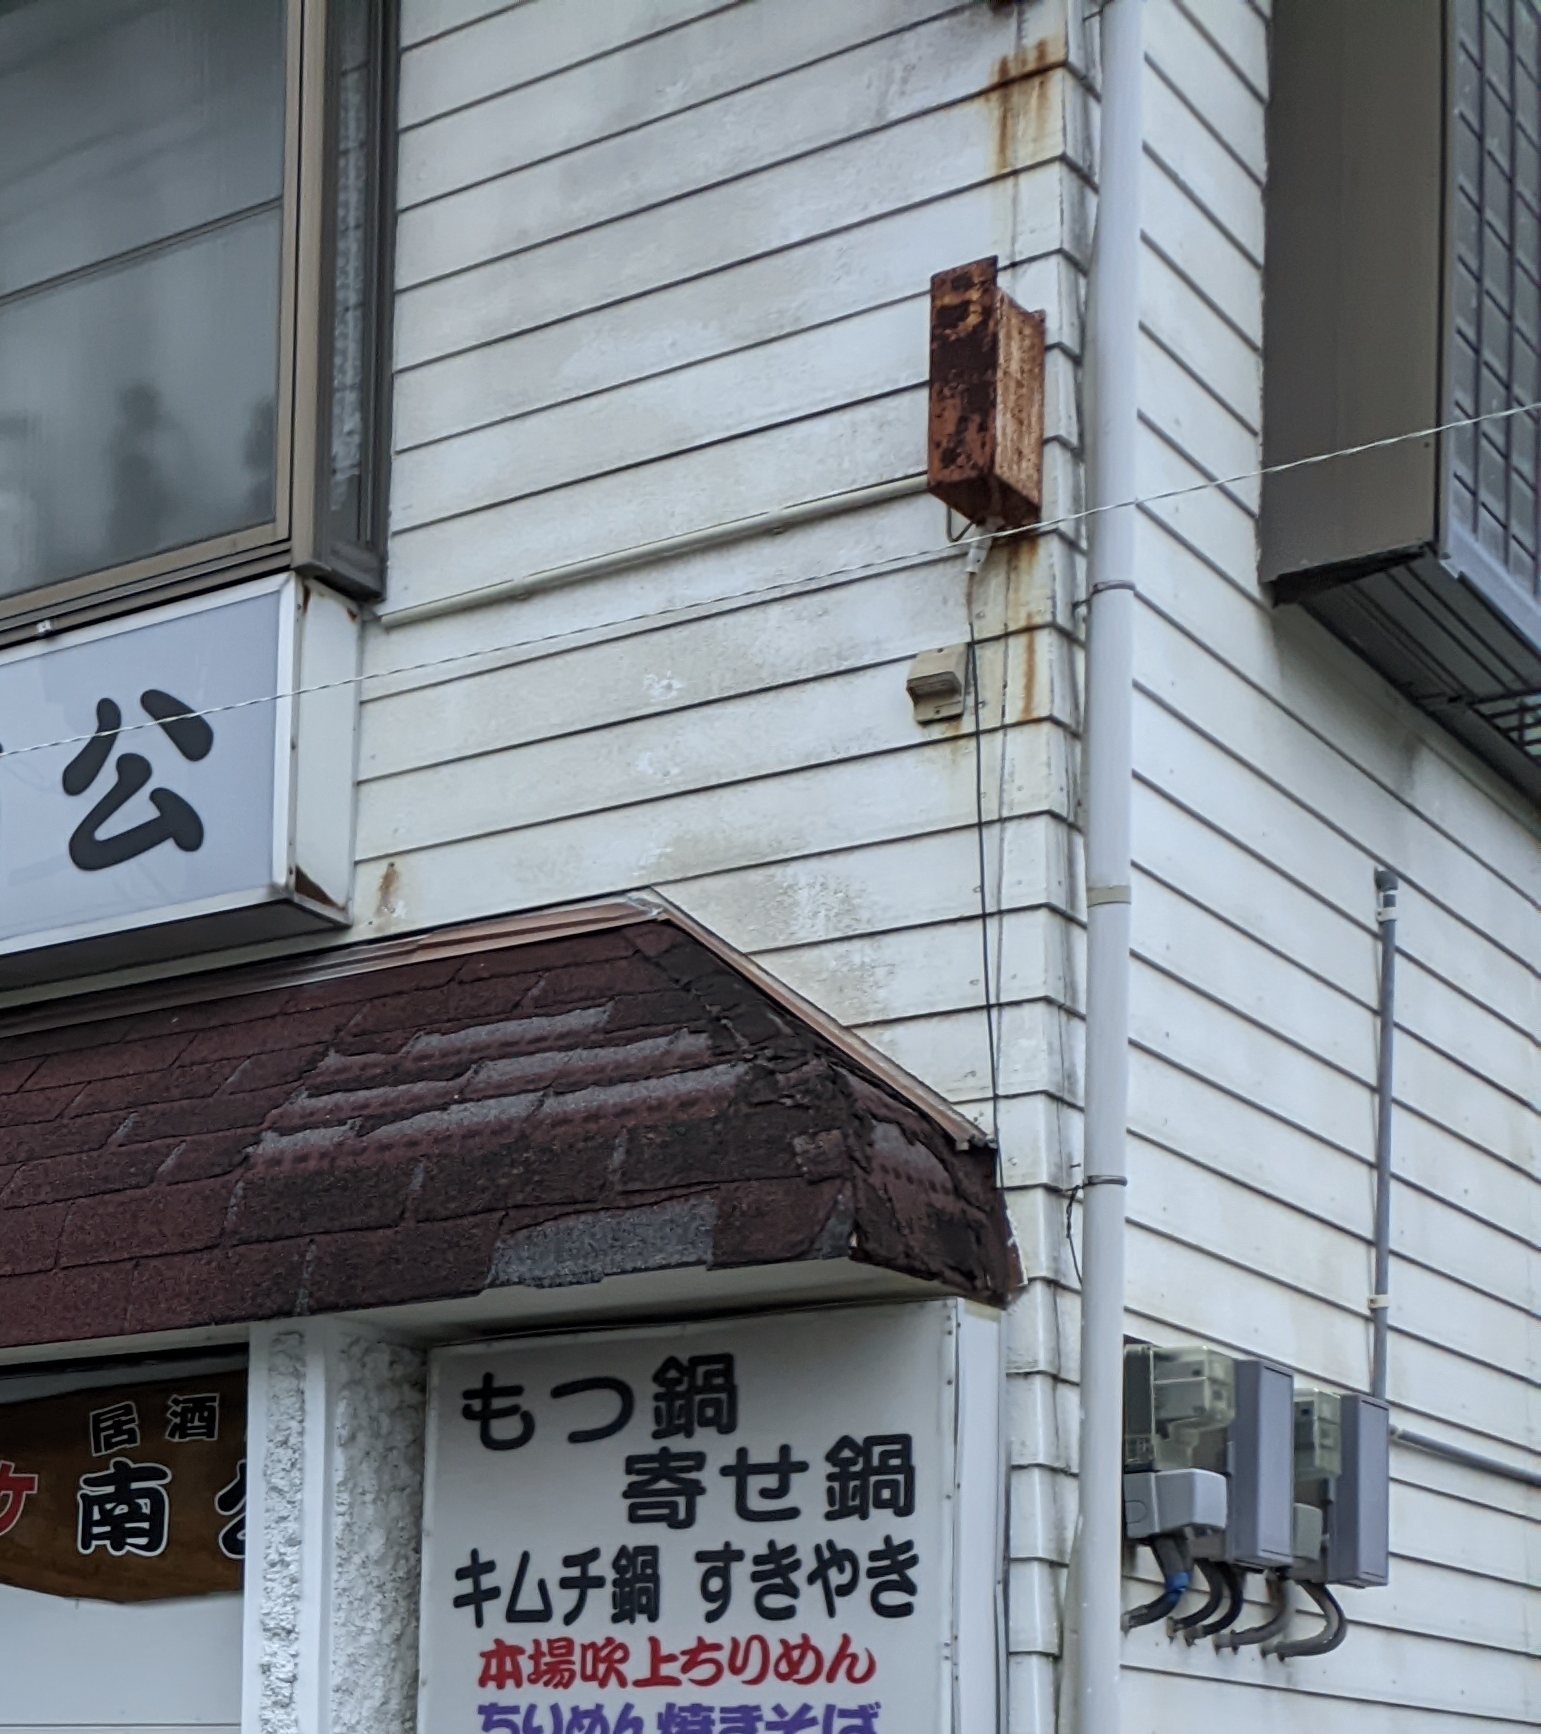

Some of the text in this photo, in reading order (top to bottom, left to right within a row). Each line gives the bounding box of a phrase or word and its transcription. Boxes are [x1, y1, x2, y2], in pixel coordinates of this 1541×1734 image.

[89, 1393, 220, 1456] 居酒
[461, 1352, 739, 1452] もつ鍋
[622, 1432, 915, 1530] 寄せ鍋
[453, 1533, 920, 1628] キムチ鍋 すきやき
[477, 1633, 877, 1689] 本場吹上ちりめん
